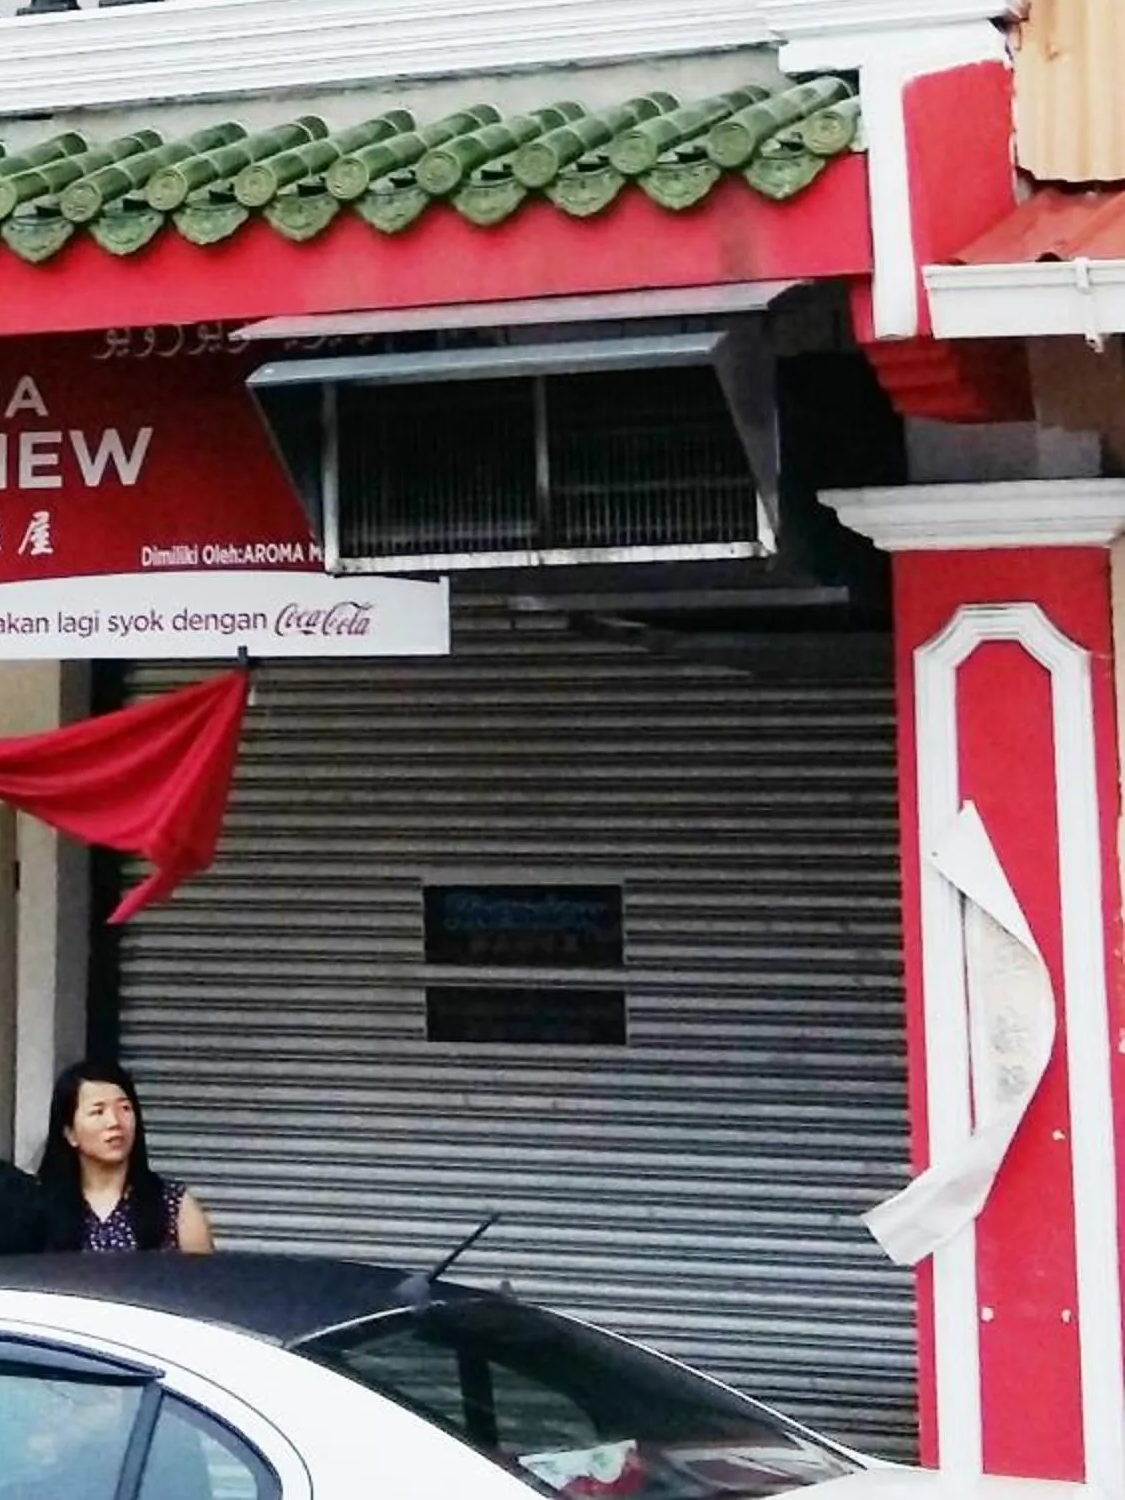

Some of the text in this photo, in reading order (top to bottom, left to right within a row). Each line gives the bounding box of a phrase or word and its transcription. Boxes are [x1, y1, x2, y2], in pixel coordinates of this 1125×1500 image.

[141, 546, 198, 567] Dimiliki
[58, 610, 100, 638] lagi
[107, 609, 165, 638] syok
[172, 607, 267, 635] dengan
